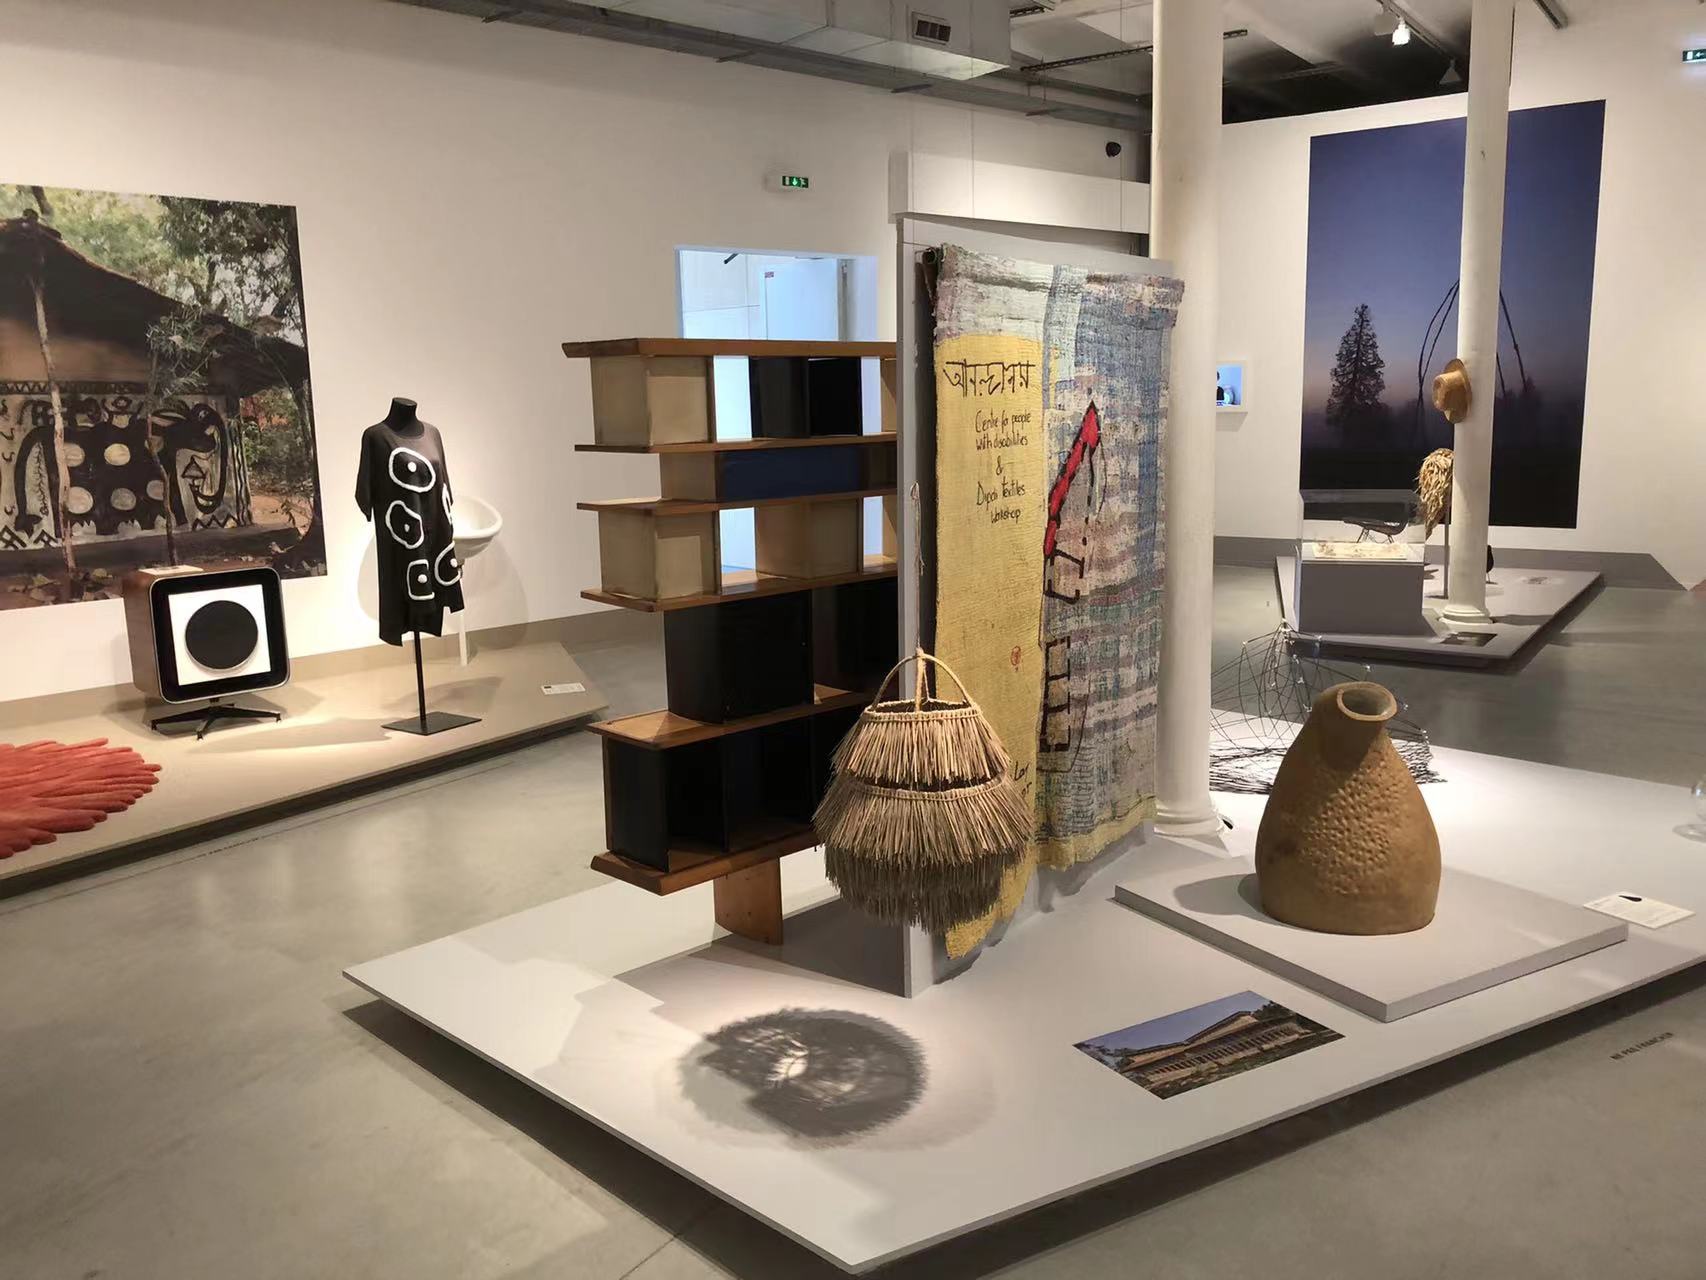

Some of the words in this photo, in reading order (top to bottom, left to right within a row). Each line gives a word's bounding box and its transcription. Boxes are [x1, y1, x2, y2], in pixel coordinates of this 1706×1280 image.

[1001, 409, 1009, 434] for
[1011, 409, 1031, 434] people
[975, 433, 993, 451] with
[995, 455, 1003, 476] &
